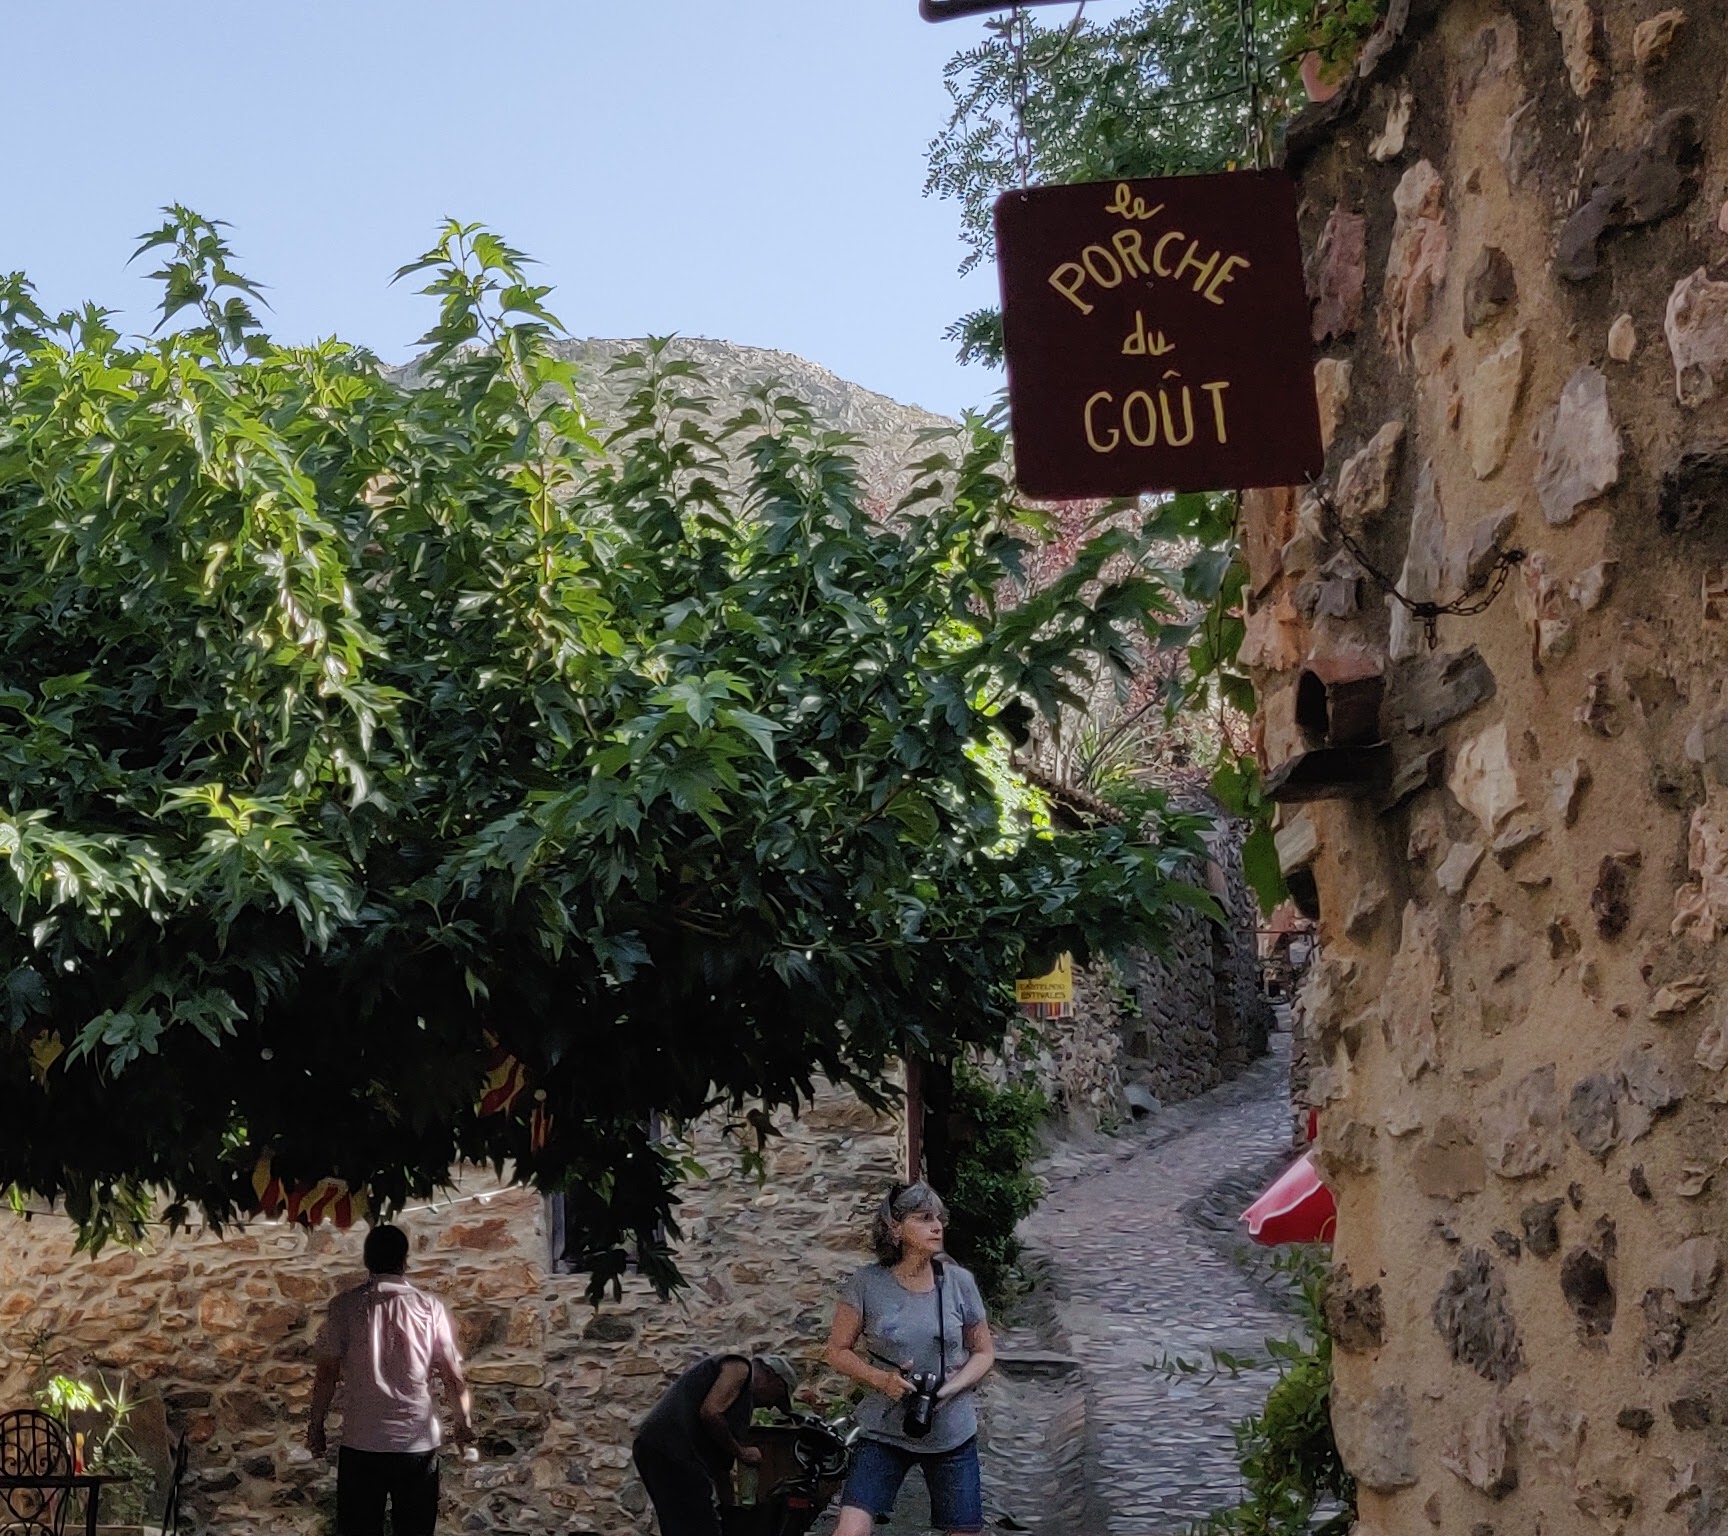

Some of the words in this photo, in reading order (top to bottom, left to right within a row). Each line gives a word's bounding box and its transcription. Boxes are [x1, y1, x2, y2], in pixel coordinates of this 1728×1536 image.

[1105, 183, 1165, 220] le
[1048, 228, 1251, 316] PORCHE
[1121, 311, 1176, 356] du
[1083, 369, 1230, 454] GOÛT
